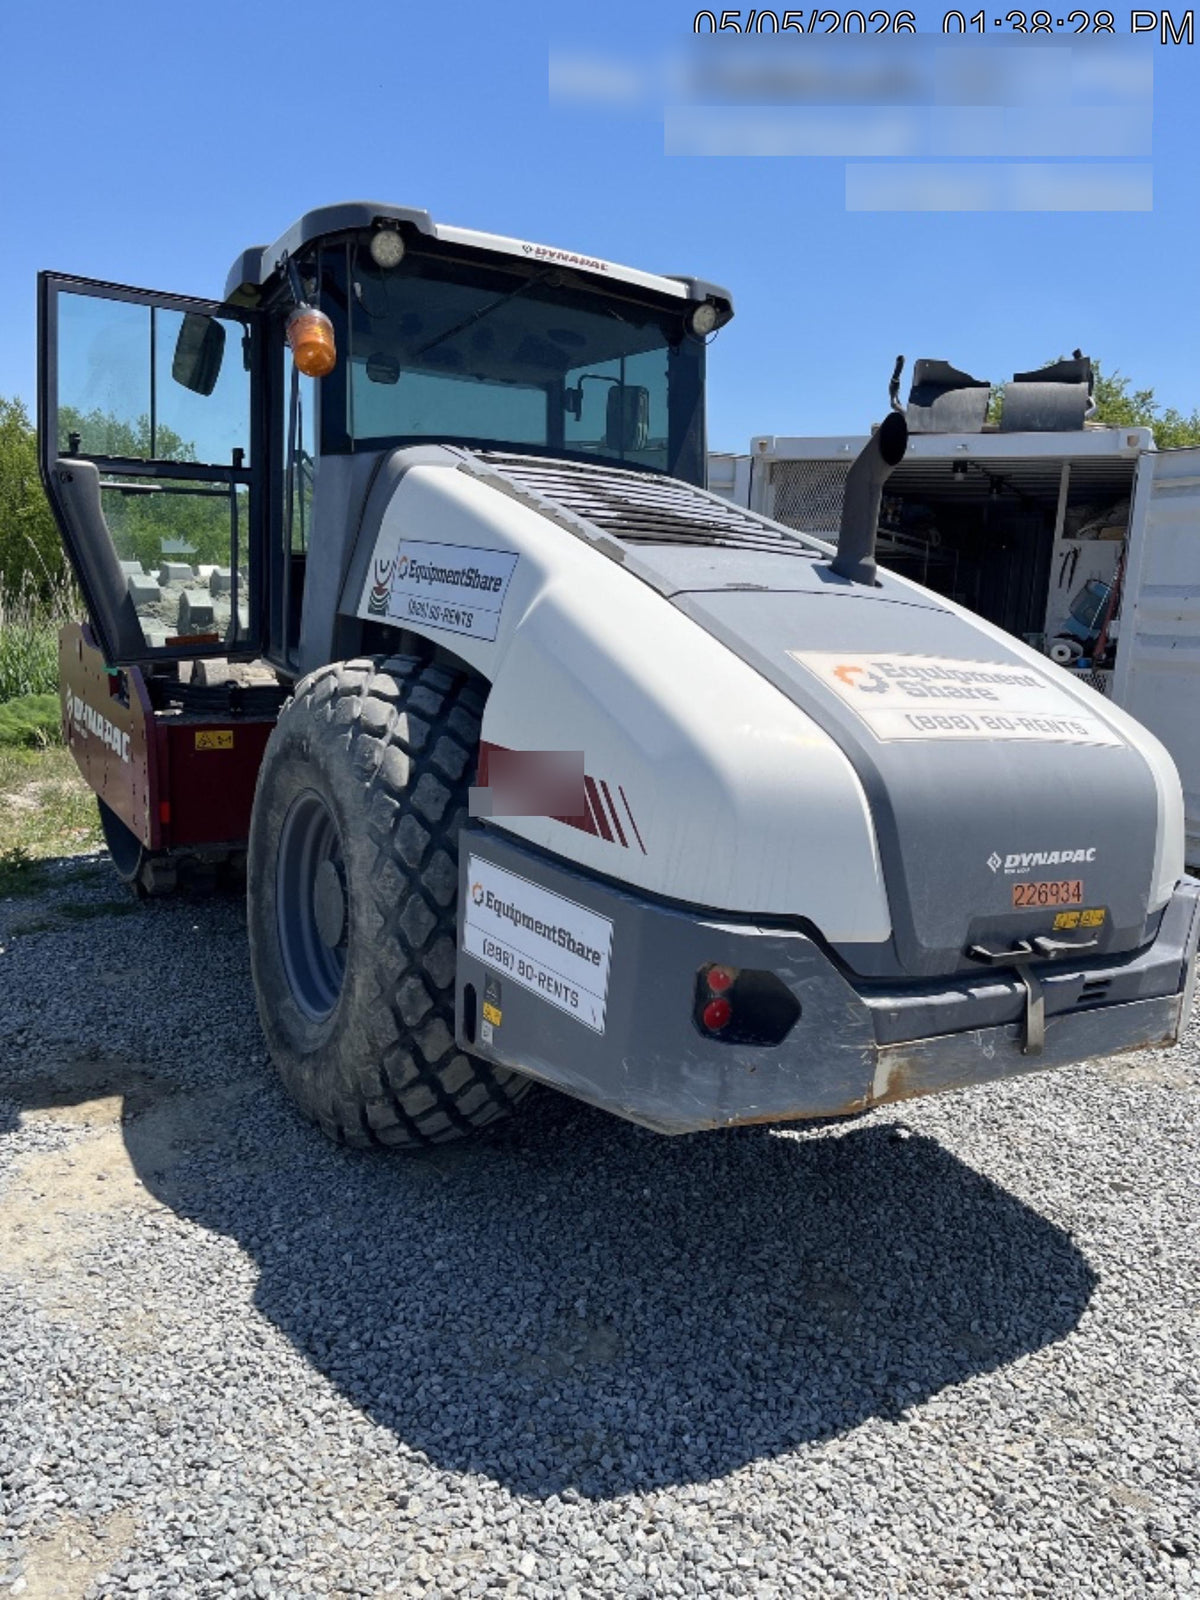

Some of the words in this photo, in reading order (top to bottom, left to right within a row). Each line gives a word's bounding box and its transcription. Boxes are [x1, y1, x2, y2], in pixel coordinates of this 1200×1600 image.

[408, 559, 502, 592] EquipmentShare
[872, 662, 1046, 689] Equipment
[895, 680, 1000, 701] Share
[904, 714, 979, 732] (888)
[1004, 847, 1096, 868] DYNAPAC
[1014, 881, 1081, 906] 226934
[485, 890, 600, 967] EquipmentShare
[517, 959, 579, 1009] 80-RENTS
